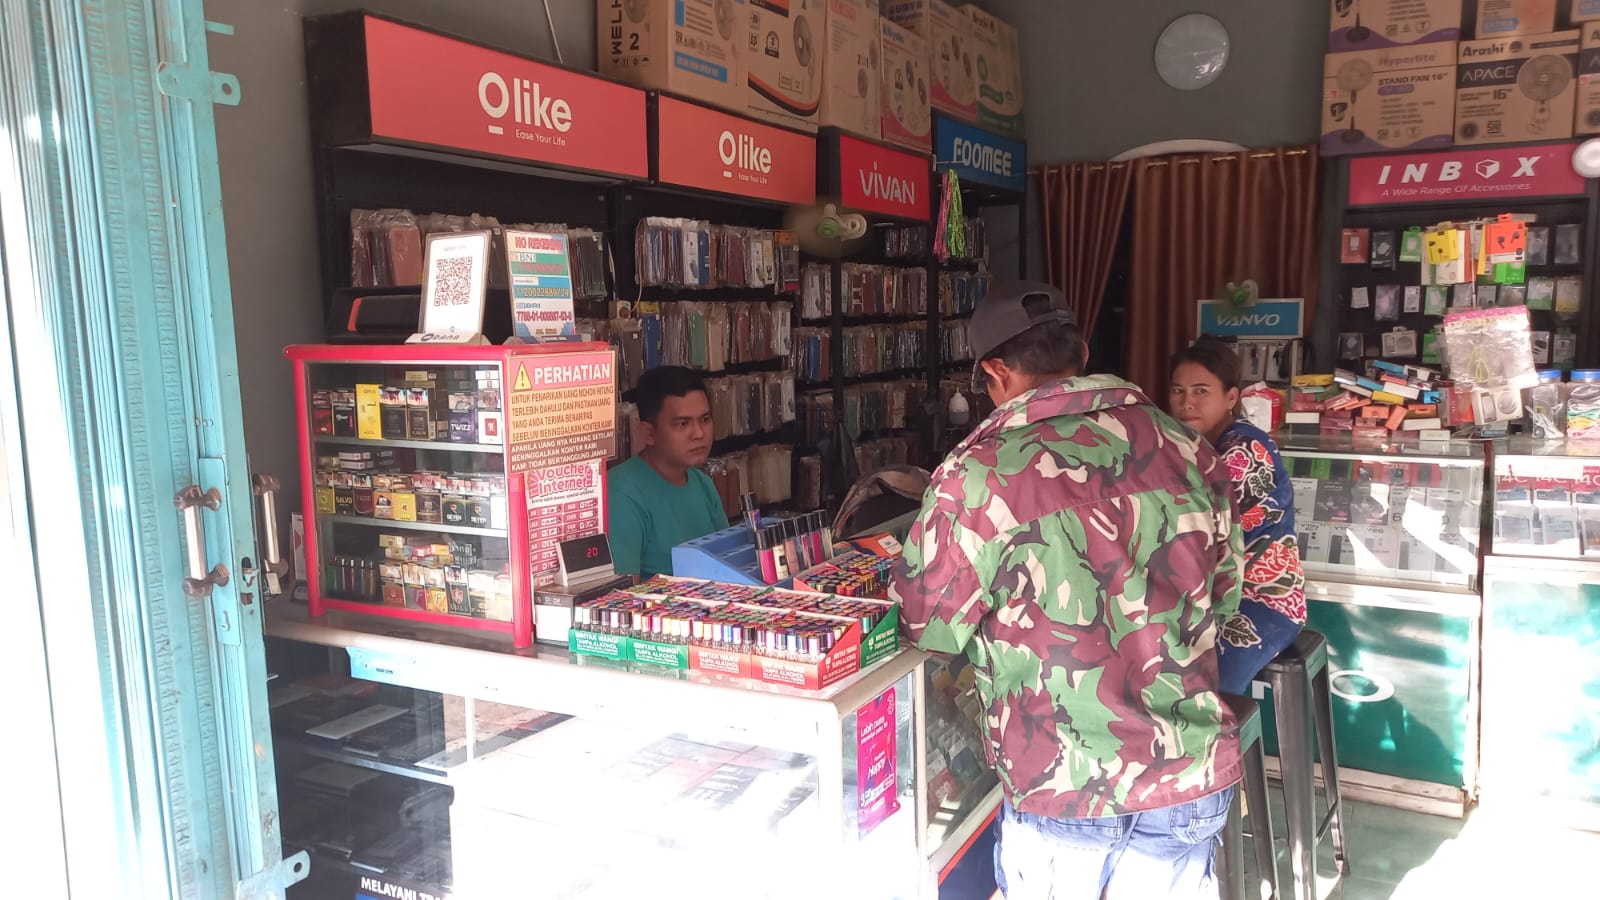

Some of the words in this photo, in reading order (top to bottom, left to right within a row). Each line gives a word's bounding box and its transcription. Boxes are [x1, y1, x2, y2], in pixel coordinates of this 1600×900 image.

[1462, 41, 1505, 58] Arashi
[478, 71, 572, 133] Olike
[515, 128, 534, 141] Ease
[535, 132, 552, 144] Your
[552, 135, 566, 146] Life
[718, 130, 772, 174] Olike
[1381, 189, 1390, 197] A
[1393, 187, 1417, 196] Wide
[1419, 186, 1452, 196] Range
[1454, 184, 1467, 193] Of
[1468, 182, 1531, 193] Accessories
[515, 237, 526, 248] NO
[534, 363, 610, 385] PERHATIAN
[511, 394, 531, 405] UNTUK
[532, 391, 563, 402] PENARIKAN
[563, 389, 578, 399] UANG
[512, 404, 539, 417] TERLEBIH
[539, 402, 562, 413] DAHULU
[562, 401, 574, 411] DAN
[512, 419, 528, 430] YANG
[528, 417, 544, 427] ANDA
[544, 415, 565, 426] TERIMA
[565, 412, 583, 423] BENAR
[583, 411, 593, 420] PAS
[512, 431, 539, 442] SEBELUM
[511, 441, 538, 453] APABILA
[538, 438, 556, 449] UANG
[511, 446, 560, 462] MENINGGALKAN
[511, 461, 528, 472] KAMI
[528, 458, 547, 469] TIDAK
[535, 463, 592, 481] Voucher
[586, 547, 598, 558] 20
[361, 877, 417, 900] MELAYANI
